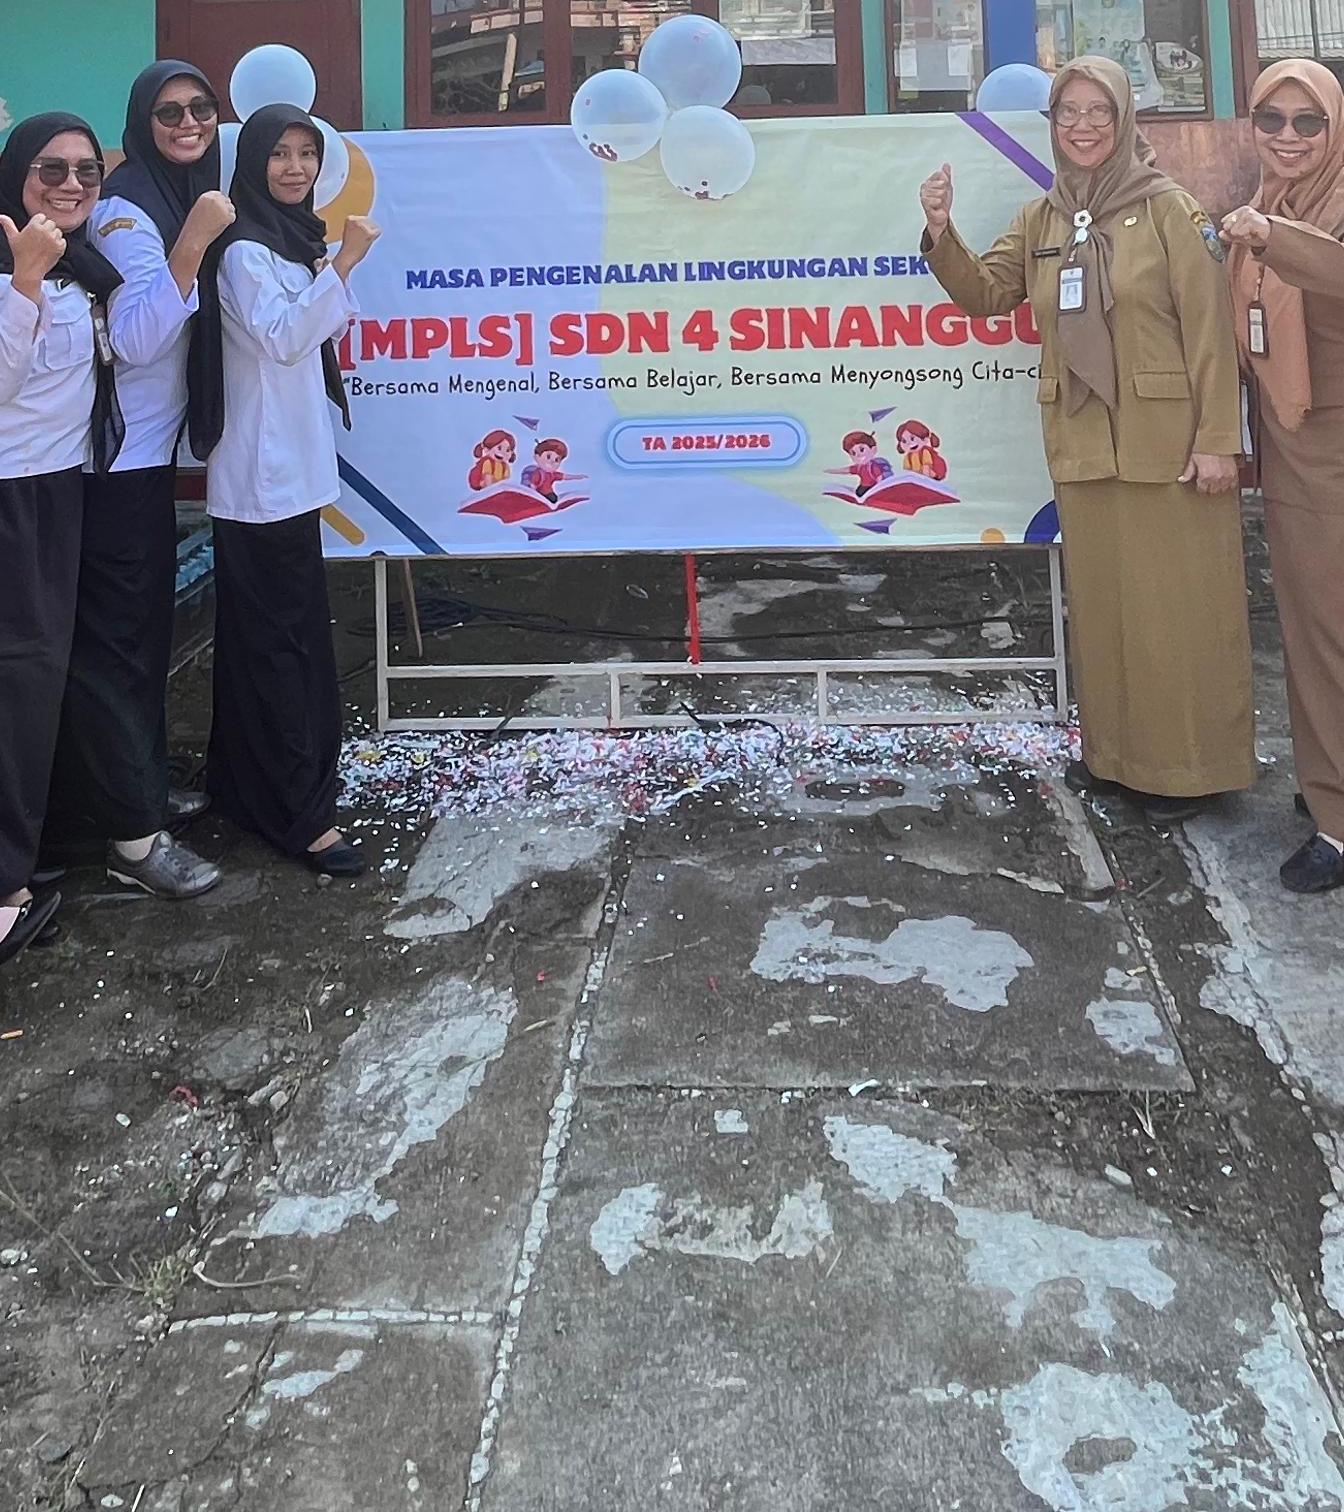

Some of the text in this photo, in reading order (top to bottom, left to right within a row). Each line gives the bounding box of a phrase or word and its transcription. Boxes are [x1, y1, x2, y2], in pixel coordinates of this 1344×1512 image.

[406, 255, 932, 290] MASA PENGENALAN LINGKUNGAN SEK
[338, 302, 1042, 371] [MPLS] SDN 4 SINANGGU
[449, 371, 540, 400] Mengenal,
[549, 371, 637, 390] Bersama
[647, 368, 722, 395] Belajar,
[731, 366, 821, 386] Bersama
[831, 364, 963, 390] Menyongsong
[972, 359, 1042, 382] Cita-ci
[642, 434, 771, 451] TA 2025/2026
